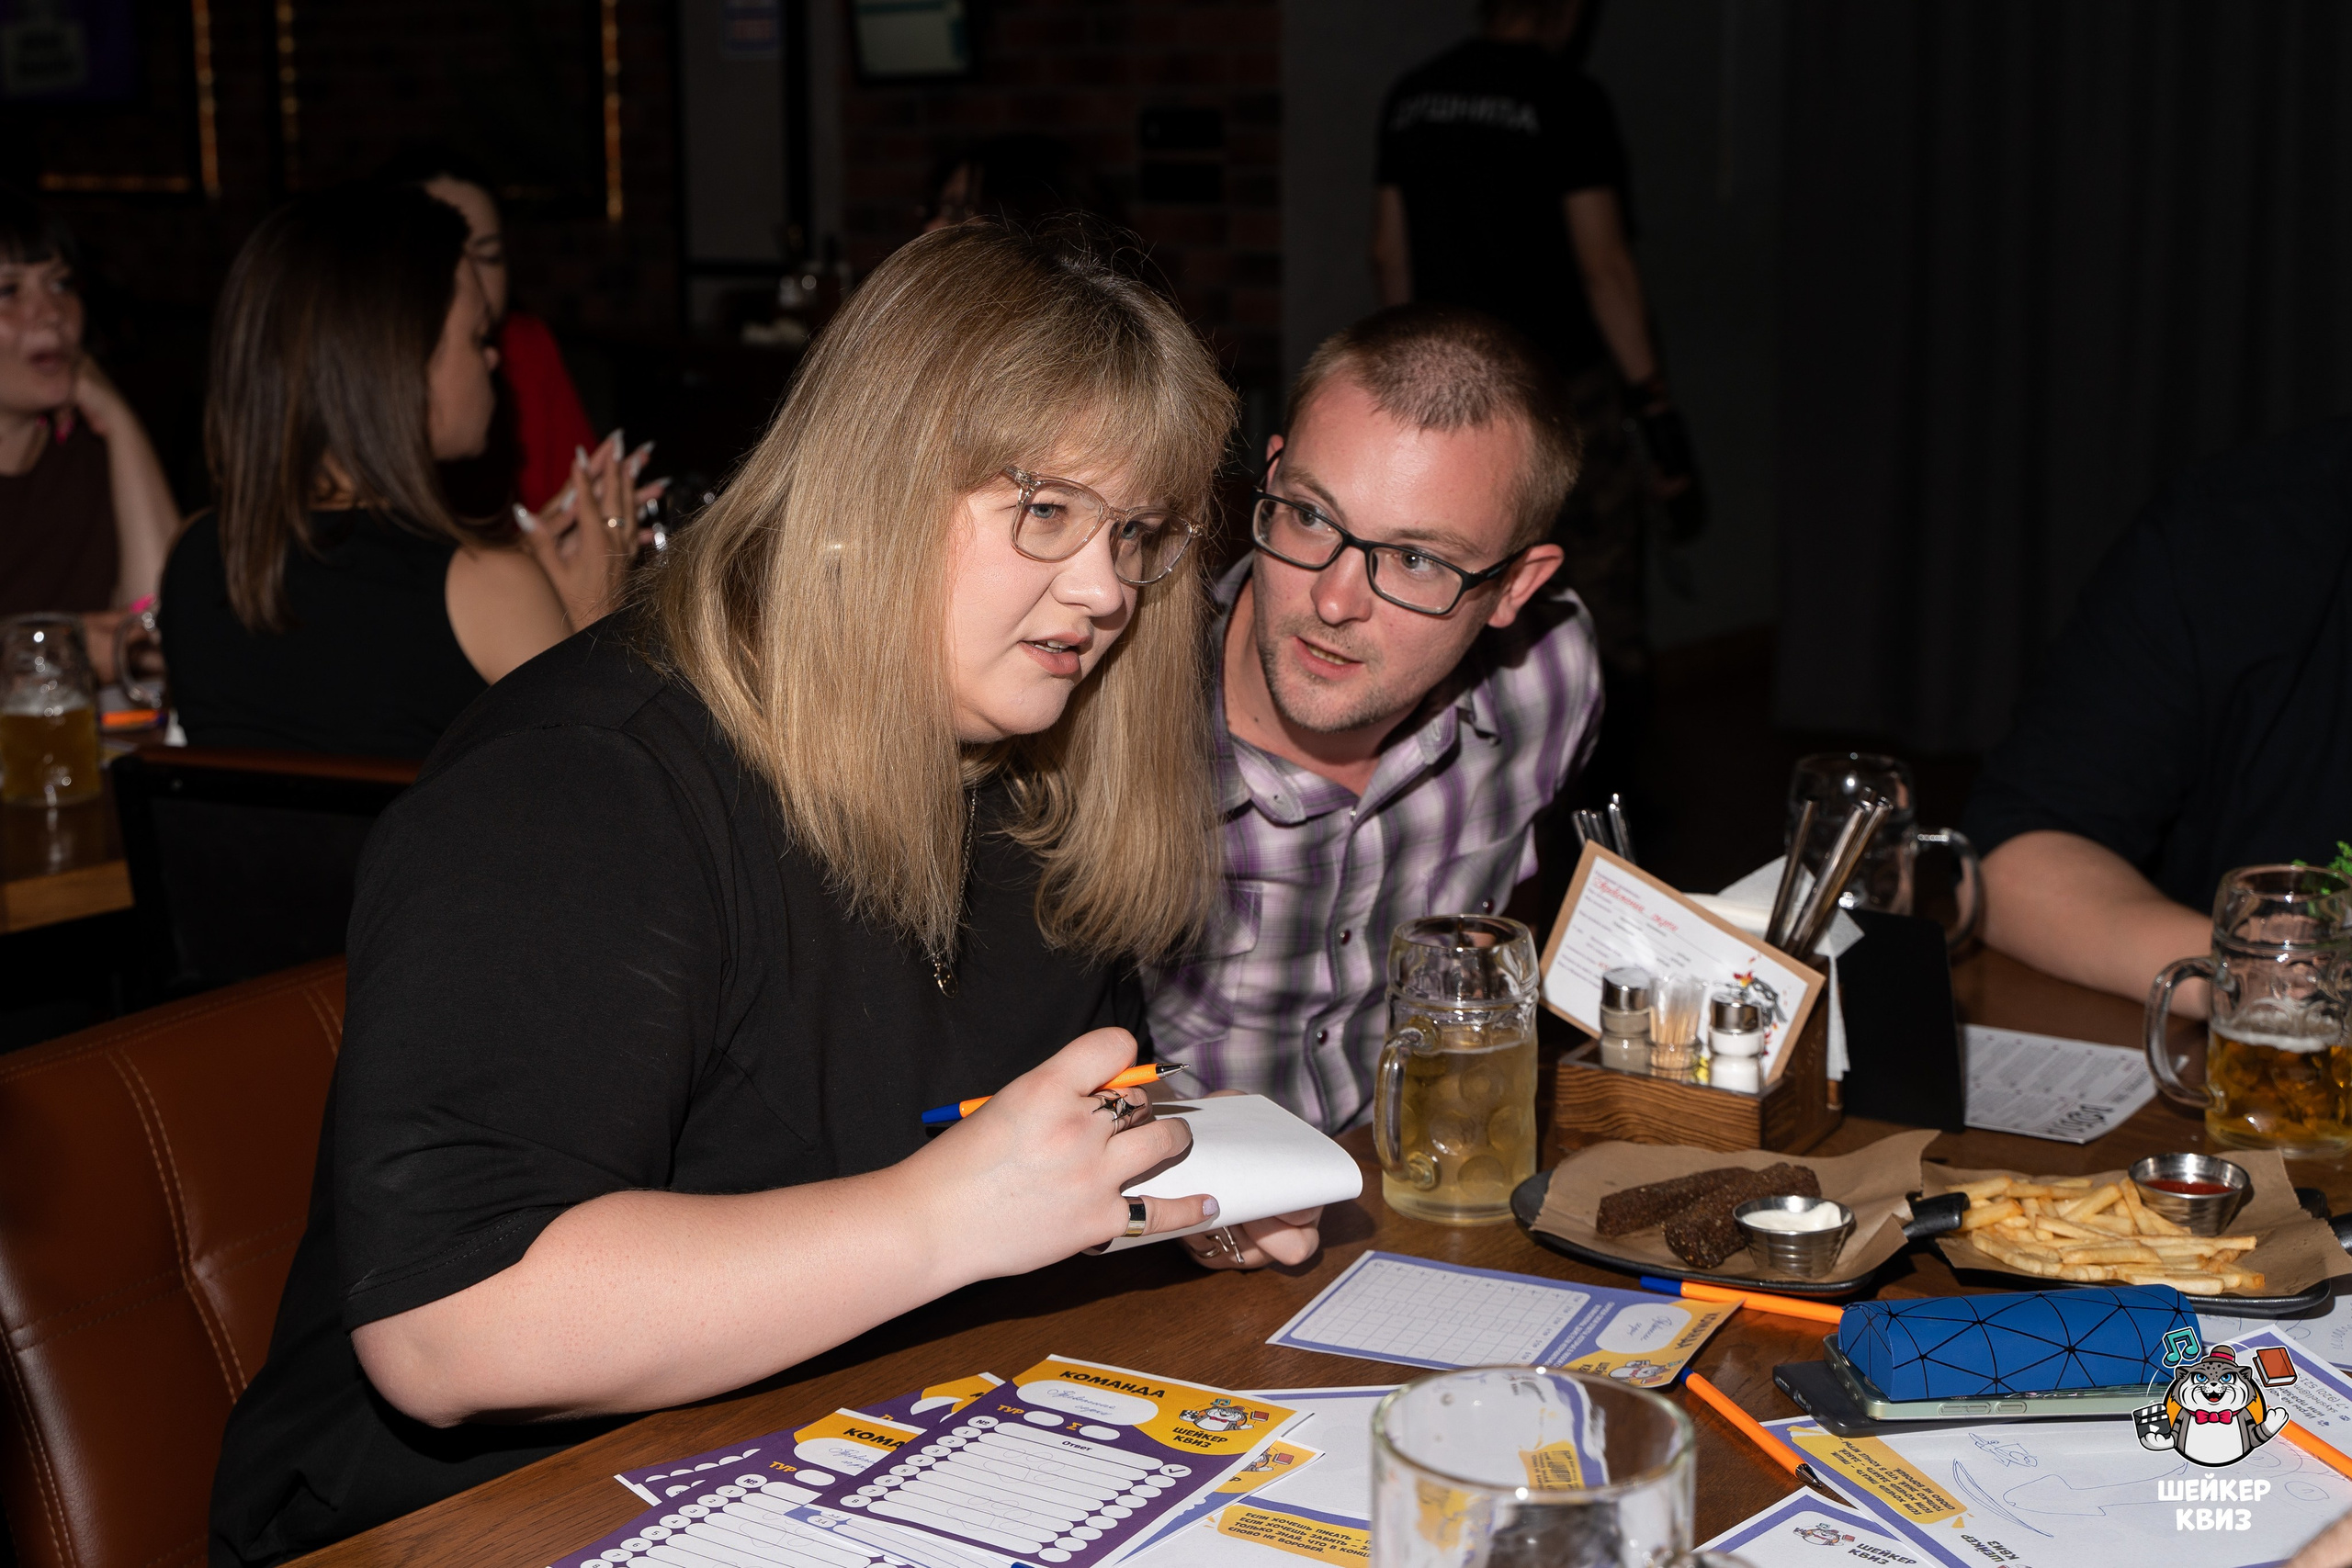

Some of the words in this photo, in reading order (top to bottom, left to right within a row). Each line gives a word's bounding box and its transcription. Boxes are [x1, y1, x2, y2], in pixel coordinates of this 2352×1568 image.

[1058, 1371, 1166, 1398] КОМАНДА
[2278, 1387, 2308, 1406] праздн
[2294, 1383, 2338, 1414] skyshell@m
[997, 1404, 1025, 1416] ТУР
[2292, 1404, 2316, 1419] Игры
[2307, 1406, 2325, 1416] или
[842, 1427, 907, 1450] КОМА
[1172, 1427, 1228, 1443] ШЕЙКЕР
[1173, 1435, 1212, 1449] КВИЗ
[1061, 1439, 1093, 1452] Ответ
[768, 1461, 797, 1472] ТУР
[1866, 1466, 1891, 1483] ЗАБИТЬ
[1856, 1469, 1880, 1484] ПИСАТЬ
[1884, 1471, 1899, 1480] ЧТО
[1879, 1484, 1906, 1503] ХОЧЕШЬ
[1890, 1483, 1917, 1502] ХОЧЕШЬ
[1903, 1503, 1922, 1516] ЕСЛИ
[1914, 1502, 1933, 1514] ЕСЛИ
[1917, 1492, 1944, 1512] ТОЛЬКО
[1931, 1494, 1956, 1510] СЛОВО
[1227, 1527, 1261, 1537] СЛОВО
[1239, 1517, 1263, 1526] ЕСЛИ
[1265, 1522, 1307, 1536] ХОЧЕШЬ
[1310, 1533, 1348, 1546] ЗАБИТЬ
[1245, 1512, 1270, 1521] ЕСЛИ
[1272, 1517, 1313, 1531] ХОЧЕШЬ
[1316, 1529, 1351, 1540] ПИСАТЬ
[1234, 1522, 1273, 1533] ТОЛЬКО
[1307, 1539, 1328, 1547] ЧТО
[1339, 1547, 1372, 1558] КОНЦ
[1961, 1534, 2006, 1562] ШЕЙКЕР
[1848, 1549, 1890, 1565] КВИЗ
[1857, 1543, 1917, 1564] ШЕЙКЕР
[1987, 1540, 2020, 1561] КВИЗ
